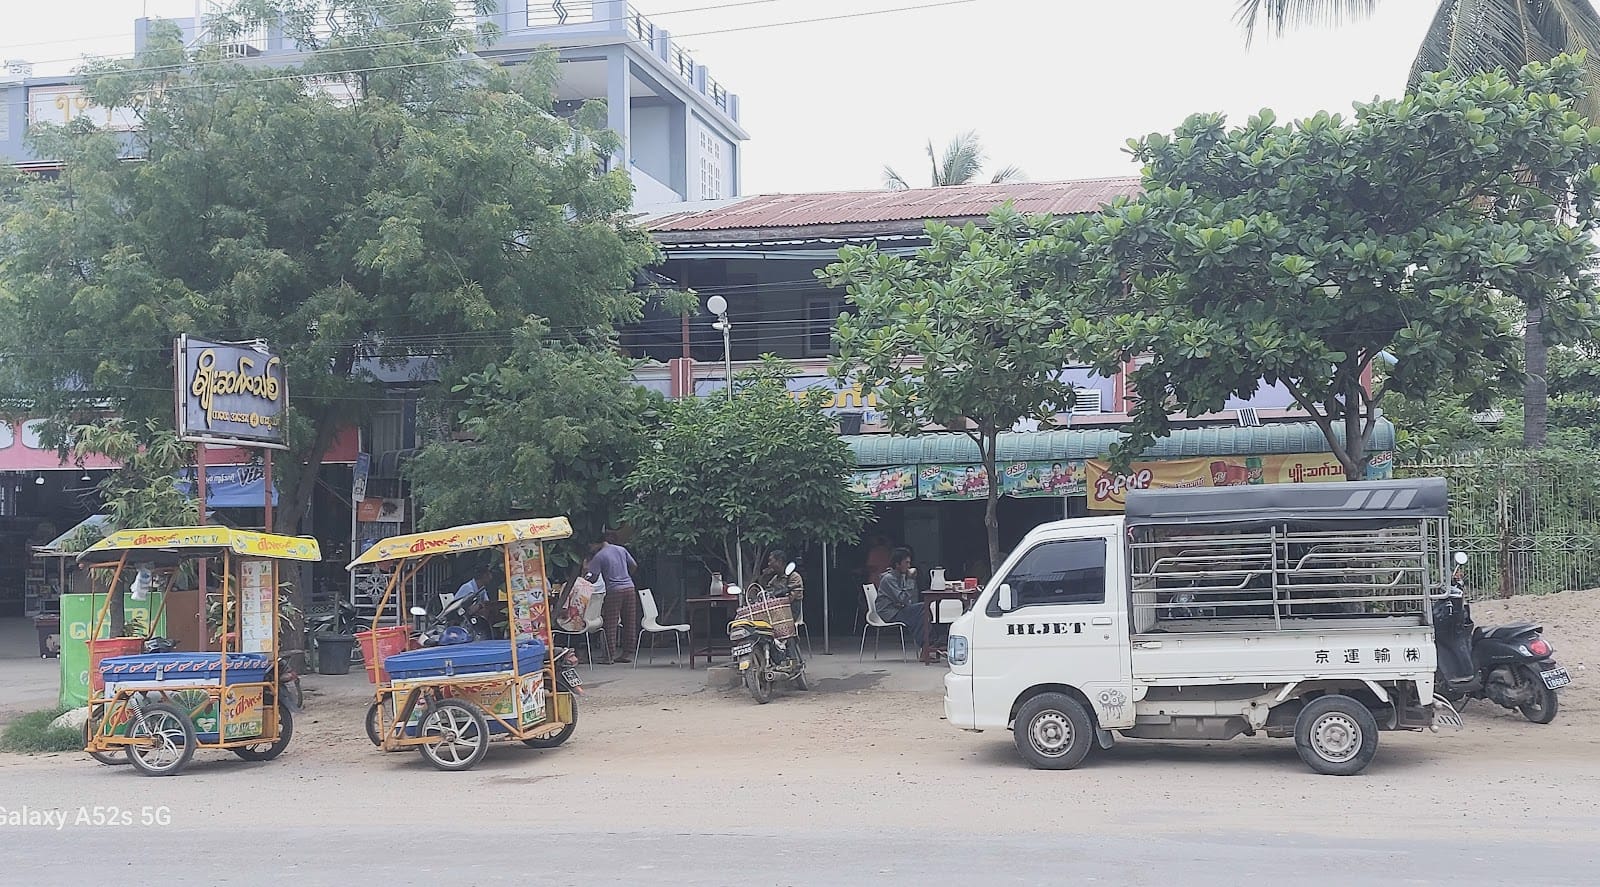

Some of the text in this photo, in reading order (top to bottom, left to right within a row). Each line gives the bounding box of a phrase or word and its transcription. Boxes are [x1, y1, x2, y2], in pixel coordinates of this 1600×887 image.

[921, 465, 941, 478] asia
[1006, 462, 1027, 476] asia
[1006, 622, 1086, 635] HIJET
